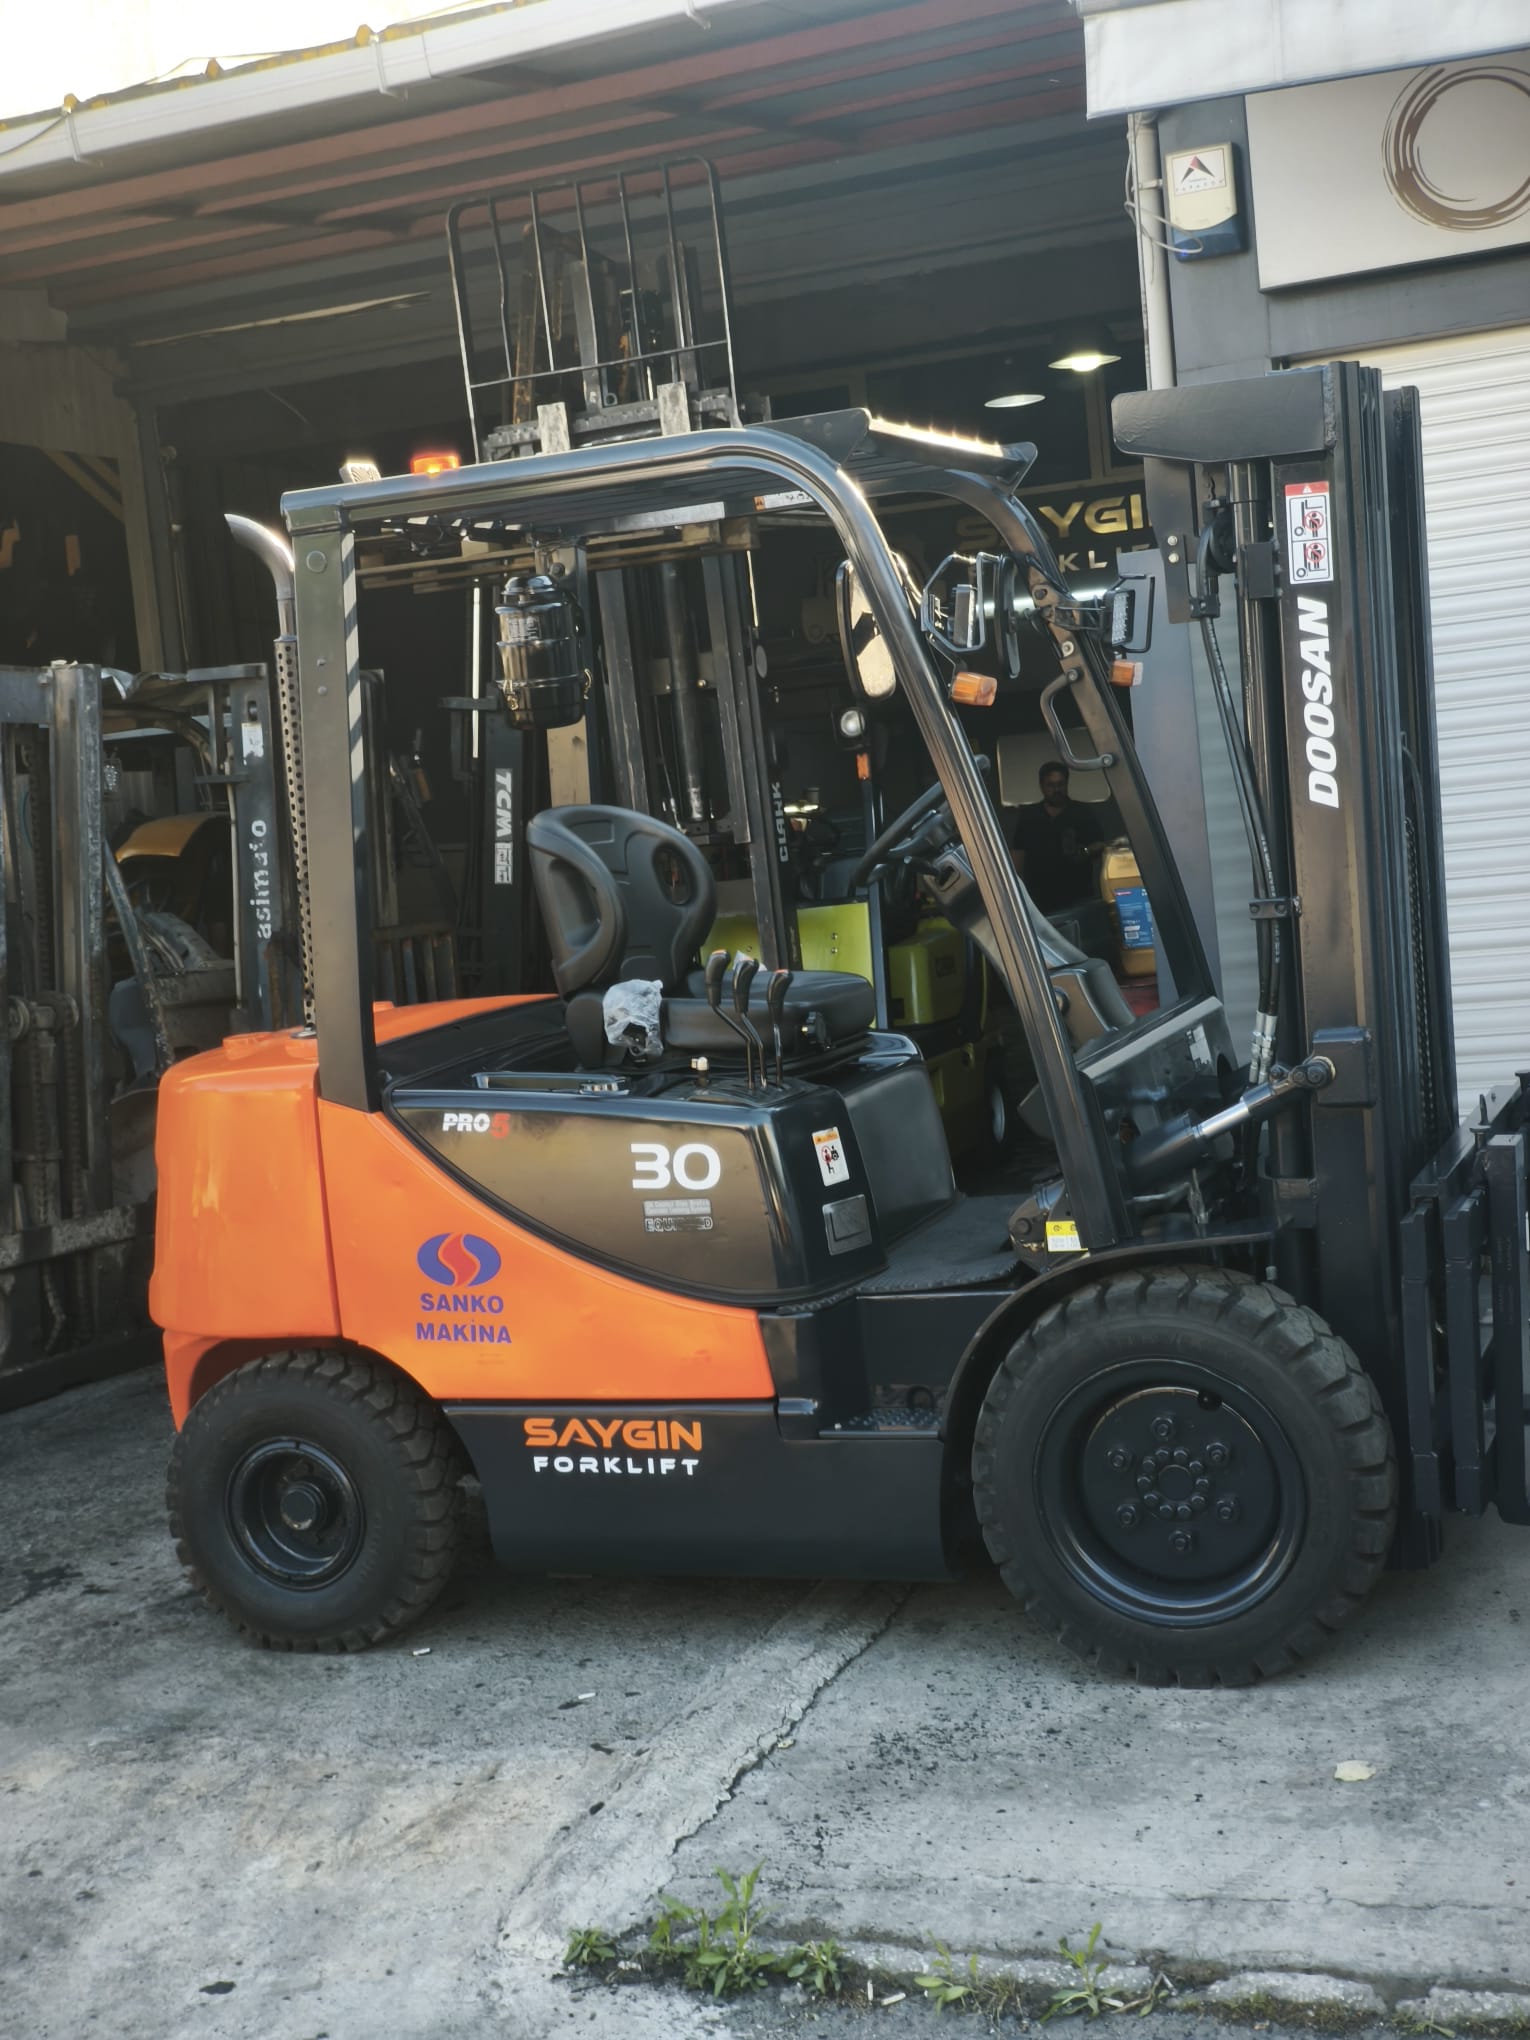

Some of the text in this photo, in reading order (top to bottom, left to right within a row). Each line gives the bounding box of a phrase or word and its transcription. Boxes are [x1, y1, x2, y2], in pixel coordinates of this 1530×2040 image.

[955, 493, 1153, 550] SYGI
[1297, 596, 1339, 808] DOOSAN
[496, 771, 512, 838] TCM
[771, 781, 789, 862] CLARK
[442, 1112, 511, 1139] PRO5
[630, 1143, 721, 1190] 30
[420, 1293, 504, 1314] SANKO
[415, 1318, 512, 1344] MAKİNA
[523, 1417, 702, 1451] SAYGIN
[533, 1456, 699, 1476] FORKLIFT
